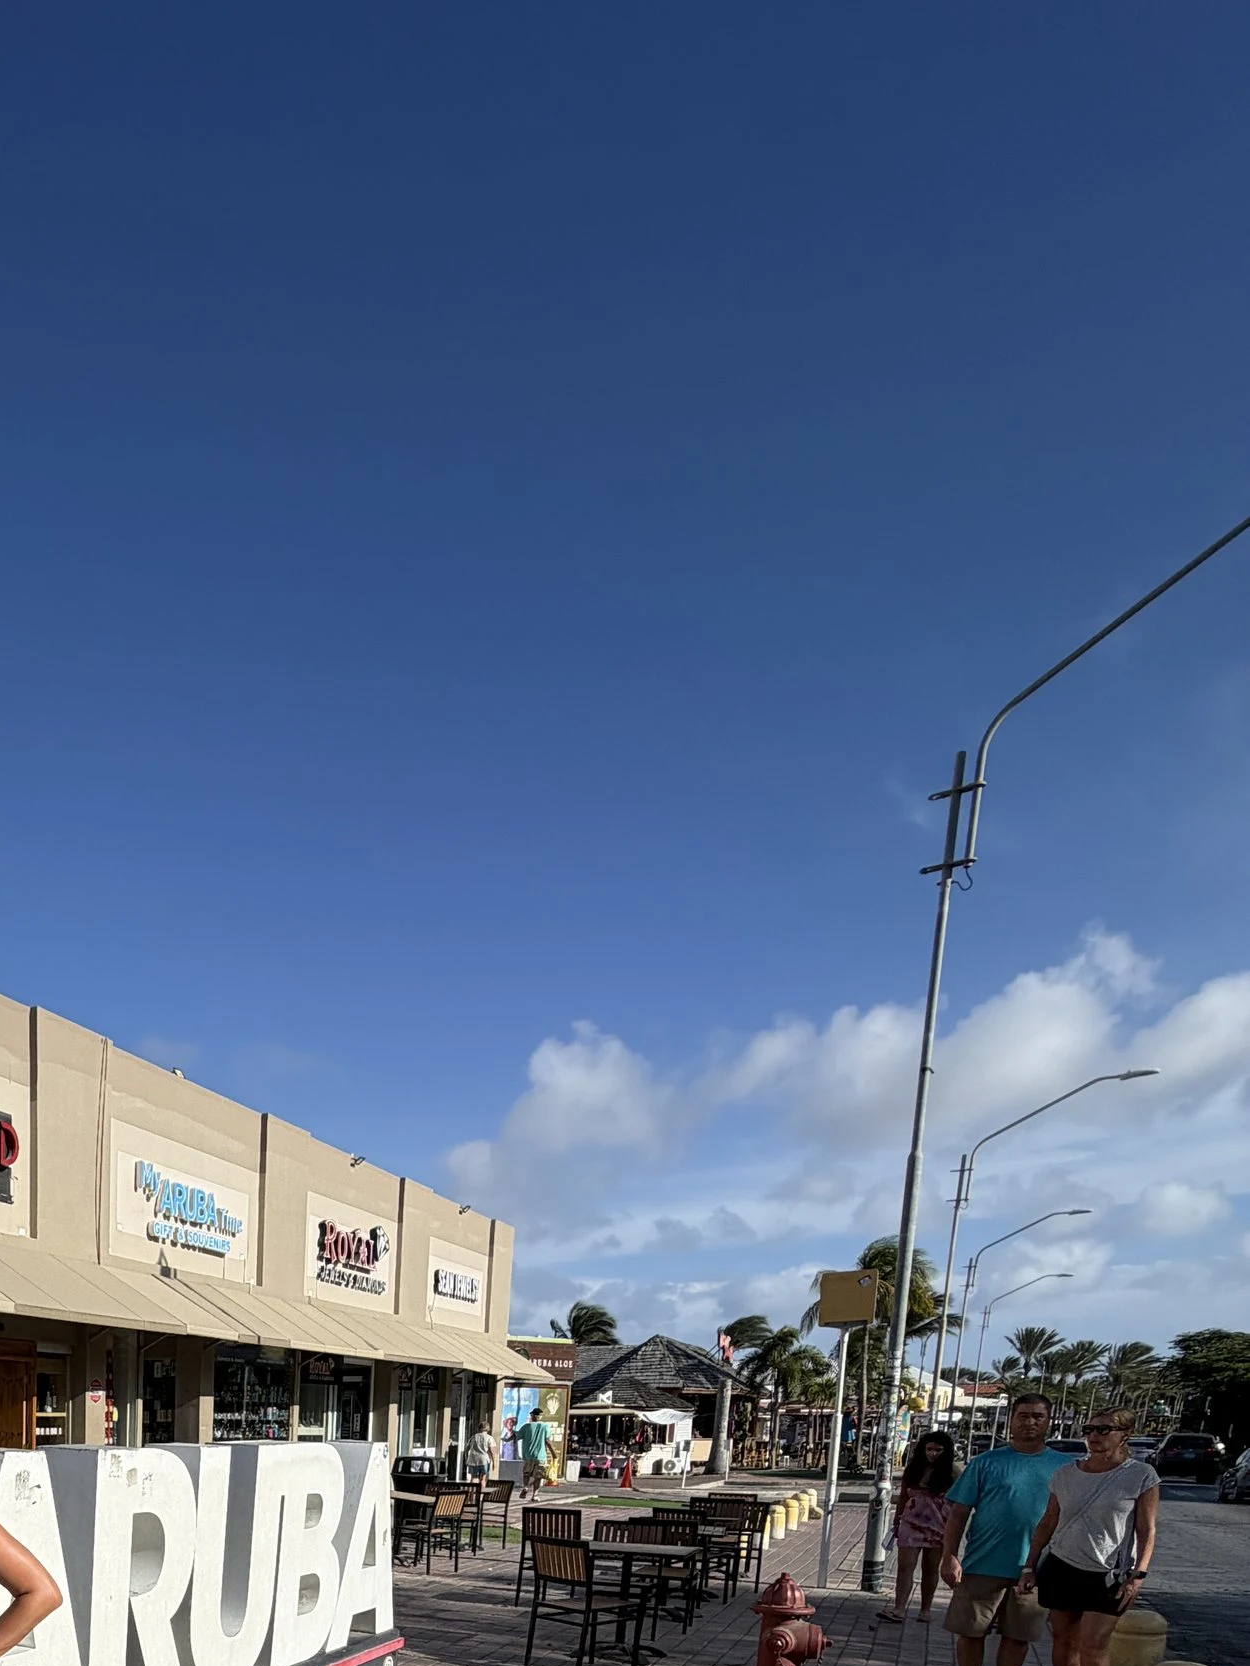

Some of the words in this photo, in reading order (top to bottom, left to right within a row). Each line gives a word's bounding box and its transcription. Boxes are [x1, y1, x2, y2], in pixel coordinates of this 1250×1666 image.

[159, 1178, 218, 1227] ARUBA
[153, 1221, 173, 1240] GIFT
[188, 1230, 231, 1253] SOUVENIRS
[321, 1219, 378, 1272] ROYAL
[530, 1358, 552, 1368] RUBA
[554, 1360, 573, 1368] ALOE
